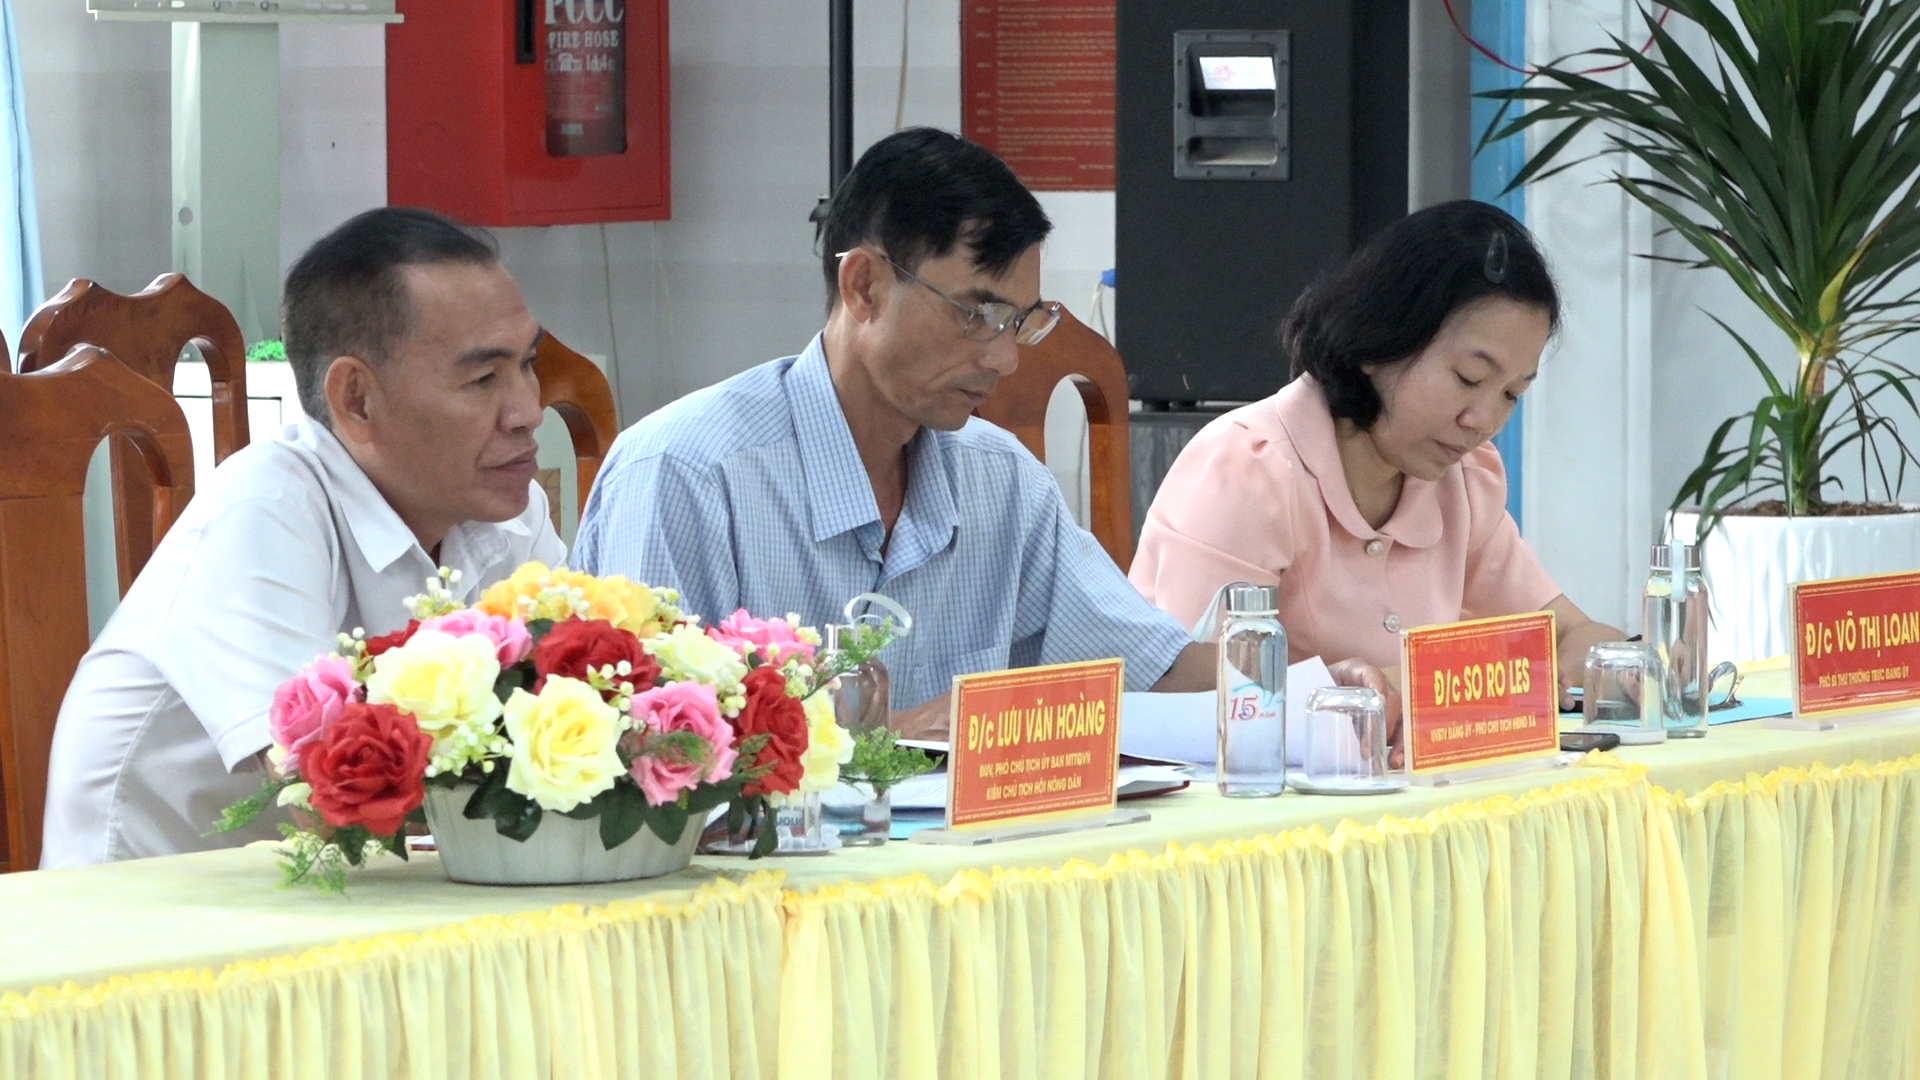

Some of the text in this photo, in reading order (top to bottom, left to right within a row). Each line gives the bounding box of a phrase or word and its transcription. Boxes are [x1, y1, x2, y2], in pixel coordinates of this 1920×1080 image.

[548, 30, 619, 48] FIRE HOSE
[1805, 610, 1920, 659] Đ/c VÕ THỊ LOAN
[1434, 657, 1531, 708] Đ/c SO RO LES
[1230, 695, 1258, 721] 15
[968, 691, 1105, 754] Đ/c LƯU VĂN HOÀNG
[1010, 754, 1025, 774] CHỦ
[1051, 755, 1064, 769] BAN
[1003, 779, 1018, 798] CHỦ
[1047, 775, 1066, 793] NÔNG
[1067, 772, 1082, 790] DÂN
